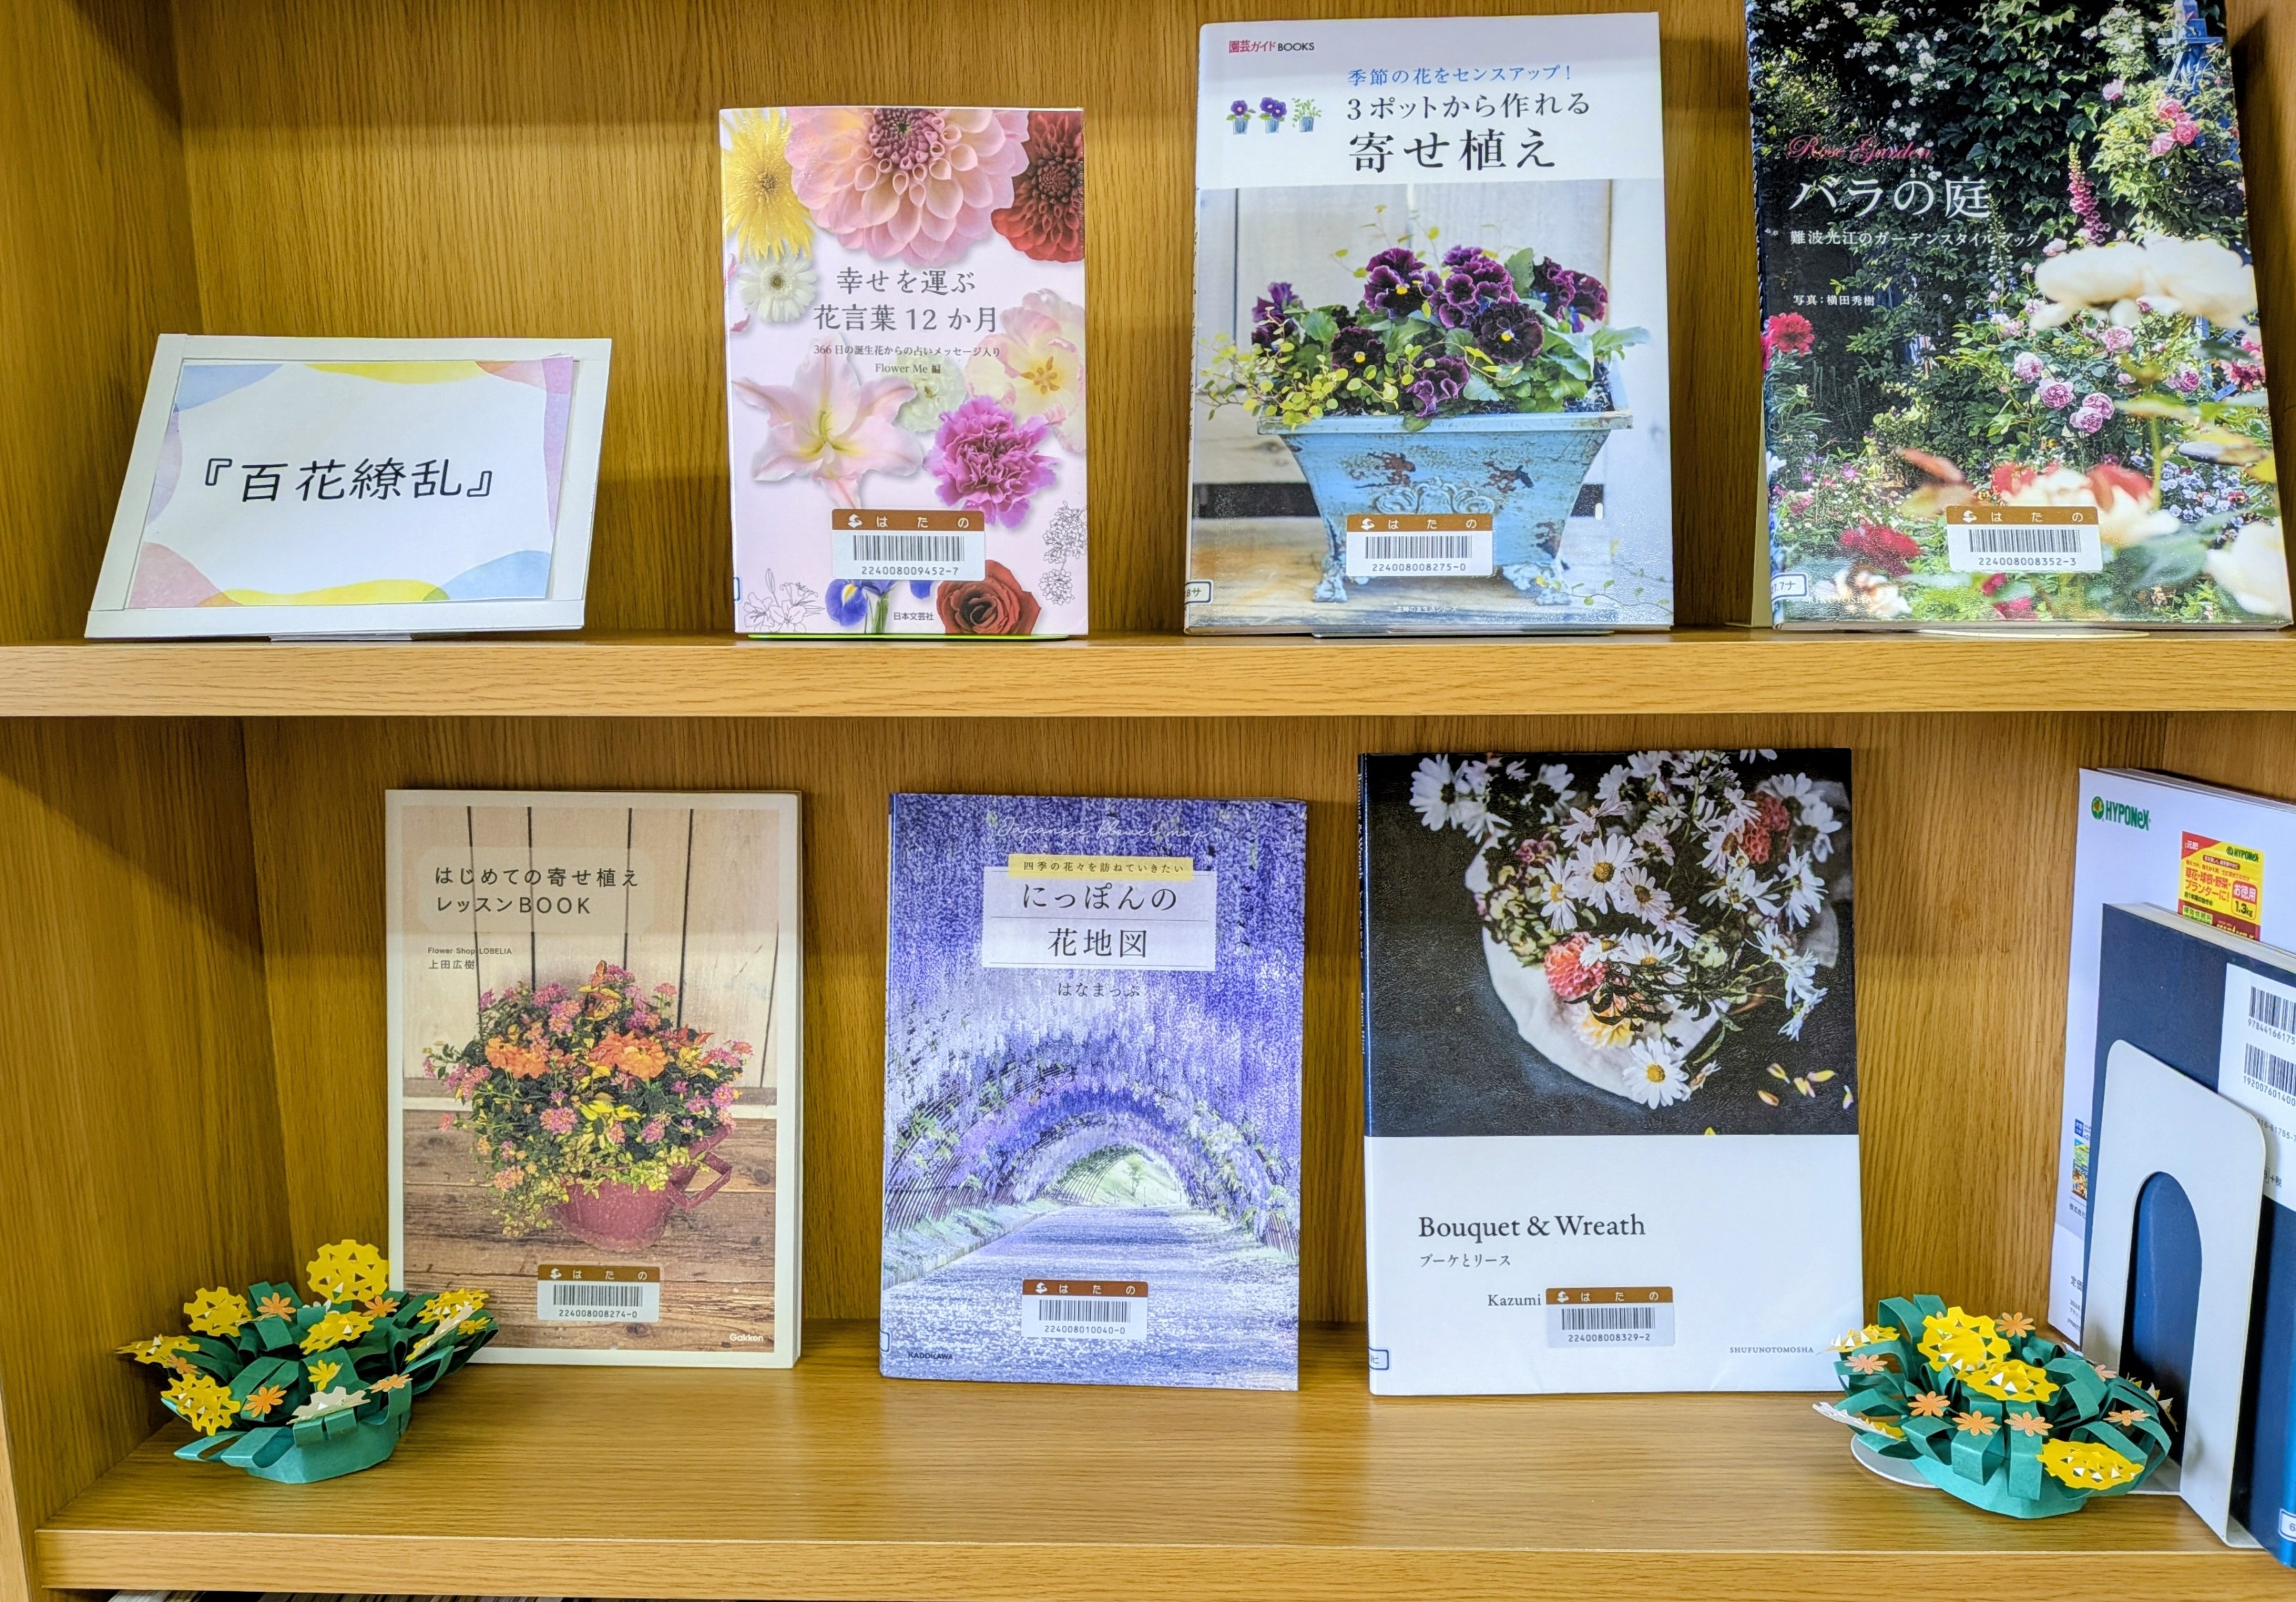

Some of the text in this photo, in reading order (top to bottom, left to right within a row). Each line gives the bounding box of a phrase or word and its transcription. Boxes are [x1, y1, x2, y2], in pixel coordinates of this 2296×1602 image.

[1347, 92, 1591, 121] 3ポットから作れる
[1349, 127, 1556, 173] 寄せ植え
[1788, 134, 1933, 164] Rose Garden
[1789, 176, 1991, 218] バラの庭
[837, 267, 975, 296] 幸せを運ぶ
[875, 363, 941, 374] Flower Me 編
[204, 456, 493, 502] 『百花繚乱』
[1372, 563, 1466, 573] 224008008275-0
[1978, 557, 2077, 566] 224008008352-3
[861, 566, 958, 576] 224008009452-7
[893, 611, 934, 621] 日本文芸社
[1024, 861, 1185, 874] 四季の花々を訪ねていきたい
[434, 866, 639, 888] はじめての寄せ植え
[1023, 882, 1177, 911] にっぽんの
[437, 896, 591, 915] レッスンBOOK
[1048, 928, 1147, 958] 花地図
[456, 947, 476, 955] Shop
[428, 959, 475, 970] 上田広樹
[1058, 982, 1140, 997] はなまっぷ
[1419, 1213, 1646, 1244] Bouquet & Wreath
[1419, 1253, 1511, 1268] ブーケとリース
[1487, 1293, 1542, 1307] Kazumi
[559, 1309, 638, 1319] 224008008274-0
[1044, 1325, 1125, 1335] 224008010040-0
[729, 1333, 764, 1343] Gakken
[1568, 1333, 1651, 1343] 224008008329-2
[1729, 1346, 1815, 1354] SHUFUNOTOMOSHA
